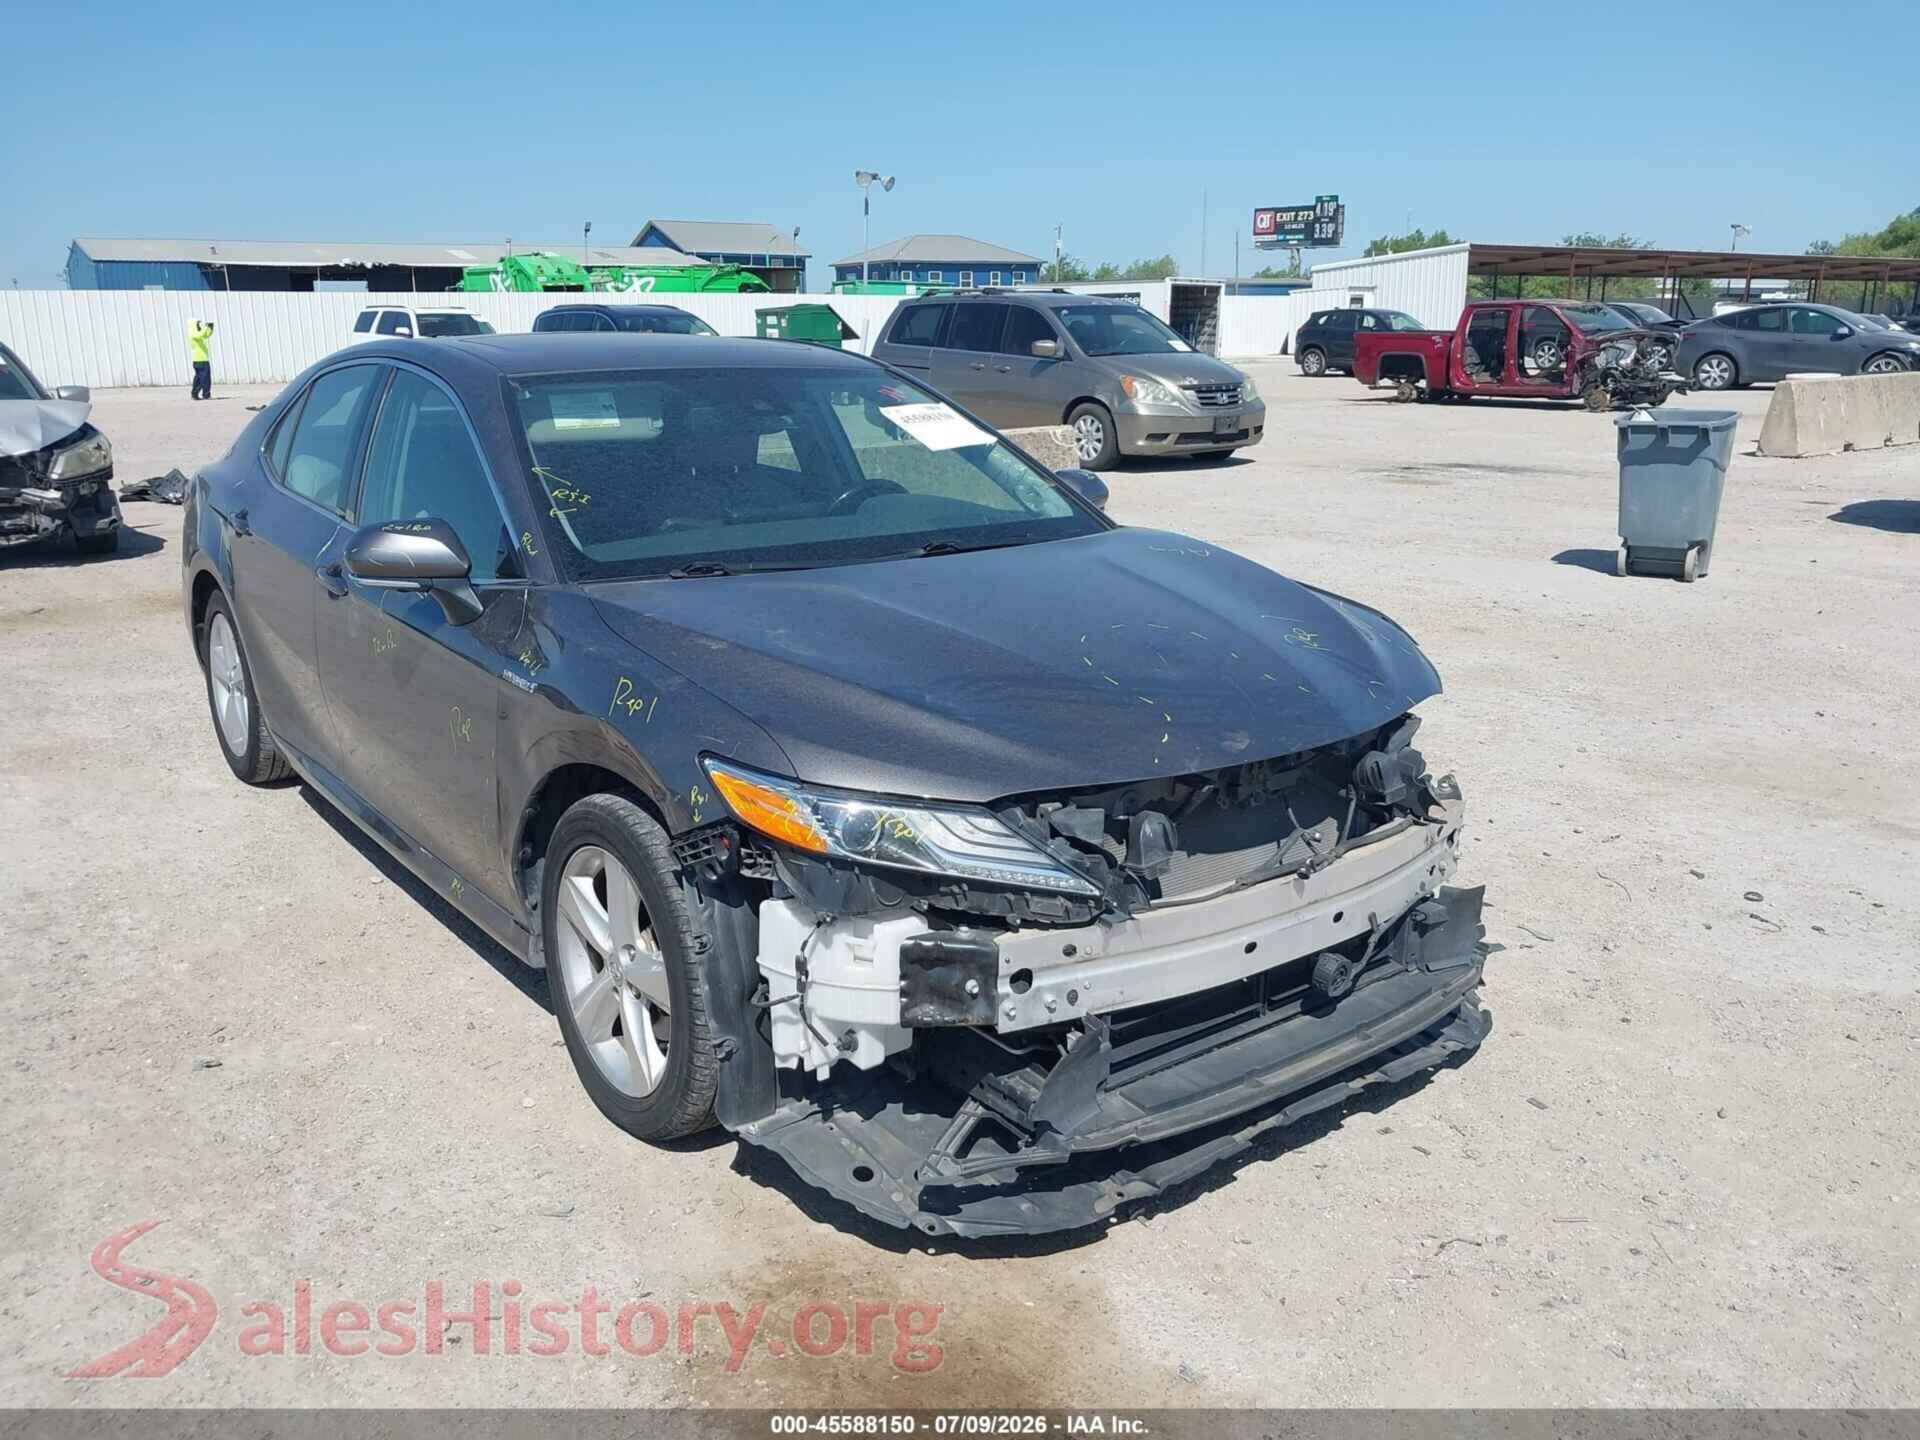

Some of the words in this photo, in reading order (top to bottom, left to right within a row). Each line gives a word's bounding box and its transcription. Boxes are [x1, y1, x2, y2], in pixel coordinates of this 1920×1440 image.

[1257, 214, 1272, 230] QT
[1276, 212, 1296, 222] EXIT
[1297, 210, 1314, 221] 273
